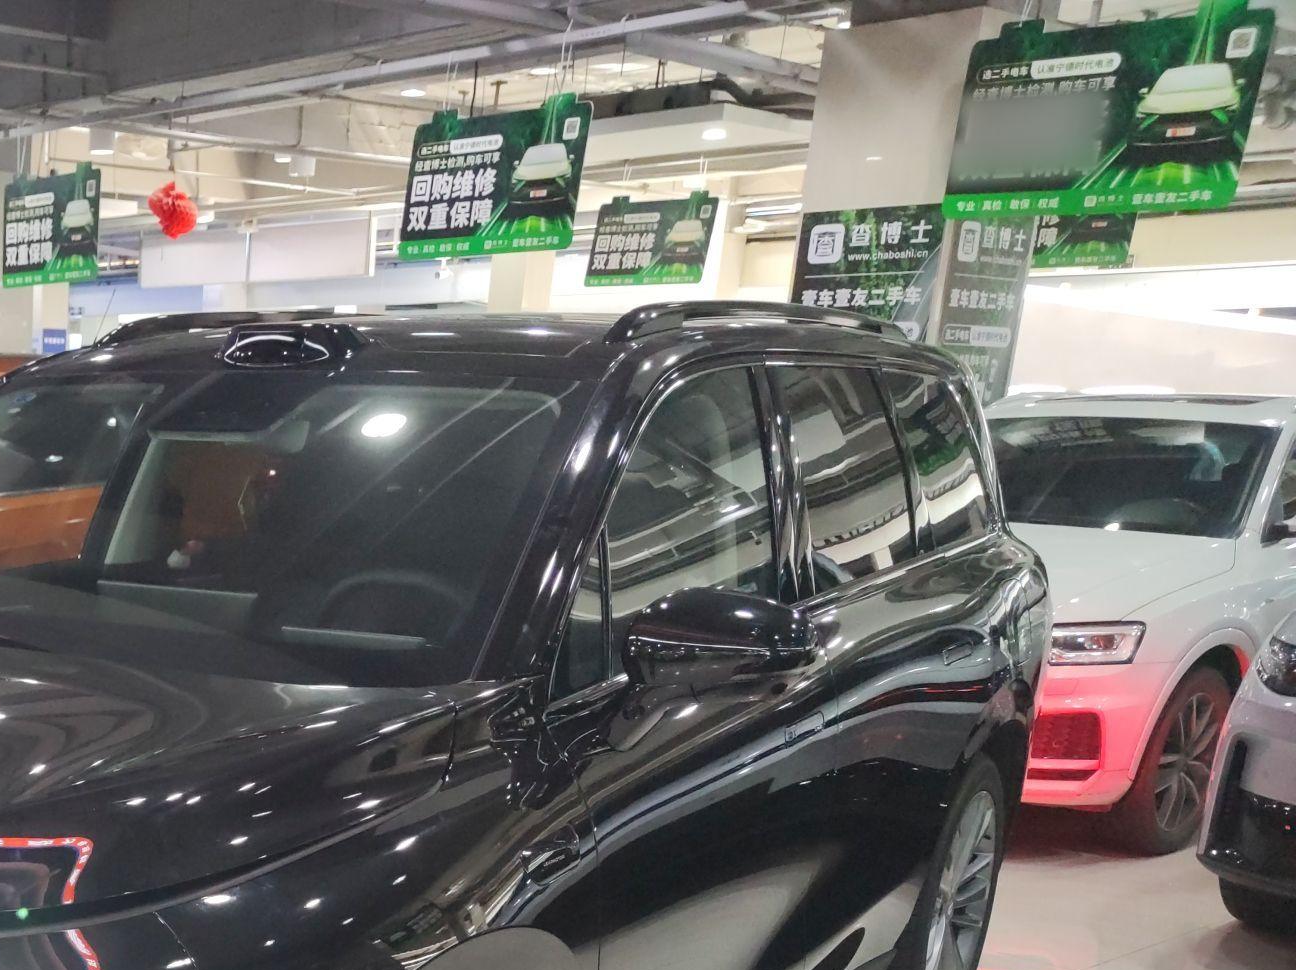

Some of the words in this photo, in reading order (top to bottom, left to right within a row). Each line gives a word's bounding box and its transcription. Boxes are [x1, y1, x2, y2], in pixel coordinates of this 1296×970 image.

[410, 167, 497, 203] 回购维修
[407, 199, 493, 231] 双重保障
[849, 219, 933, 247] 查博士
[981, 225, 1026, 251] 查博士
[847, 249, 929, 262] www.chaboshi.cn
